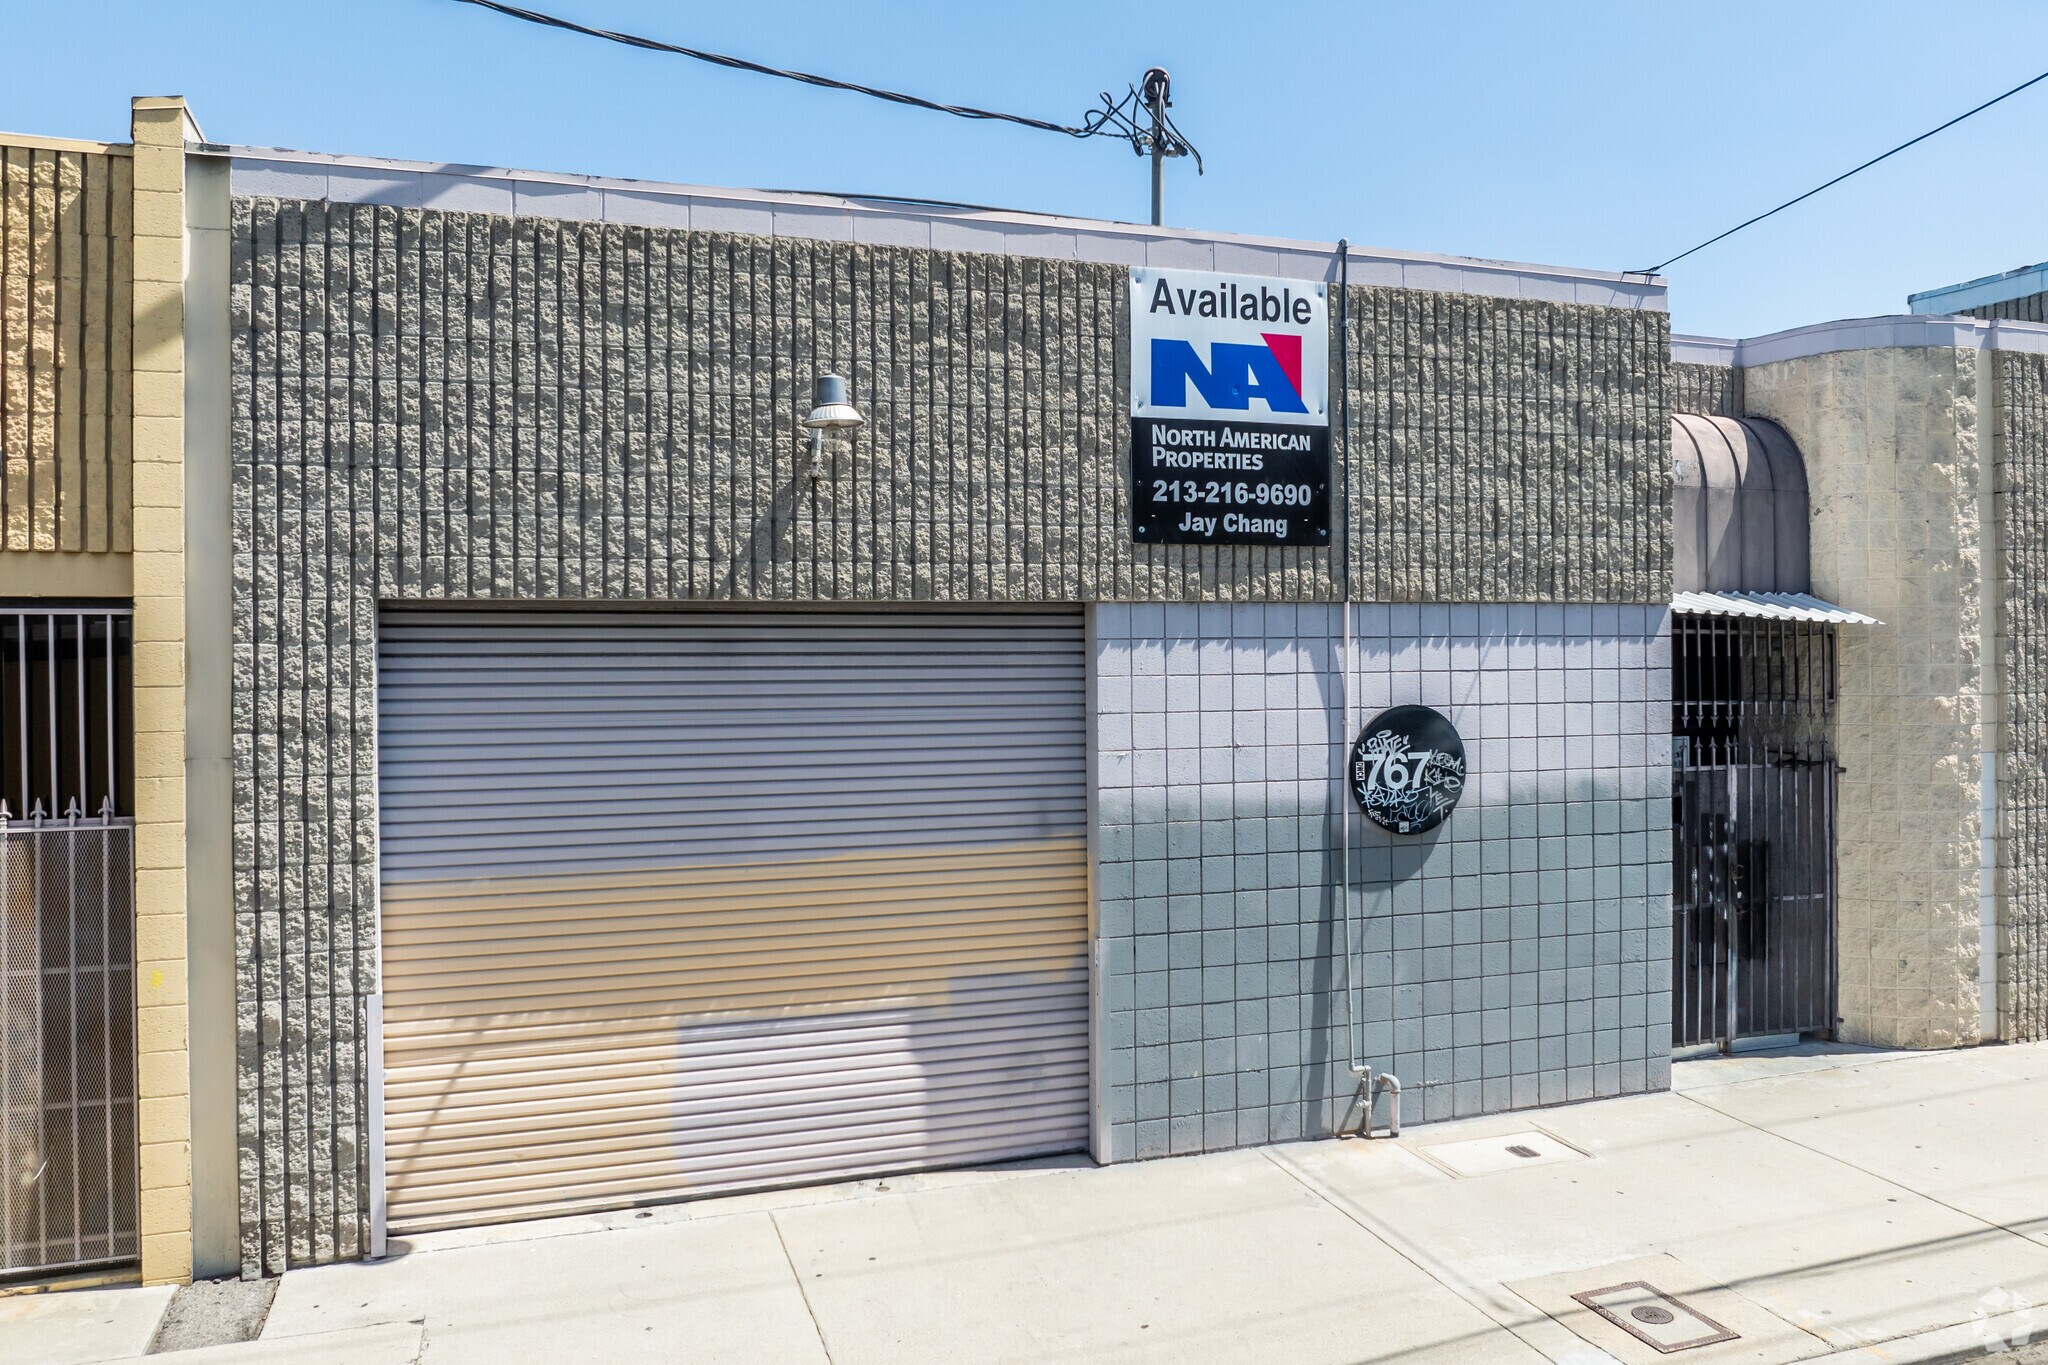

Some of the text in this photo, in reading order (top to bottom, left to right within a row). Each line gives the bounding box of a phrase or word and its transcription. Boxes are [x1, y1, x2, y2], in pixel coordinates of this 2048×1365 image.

[1150, 278, 1311, 325] Available
[1151, 333, 1309, 414] NA
[1152, 424, 1311, 451] NORTH AMERICAN
[1152, 447, 1263, 471] PROPERTIES
[1152, 480, 1311, 506] 213-216-9690
[1178, 512, 1288, 538] Jay Chang
[1362, 751, 1430, 790] 767
